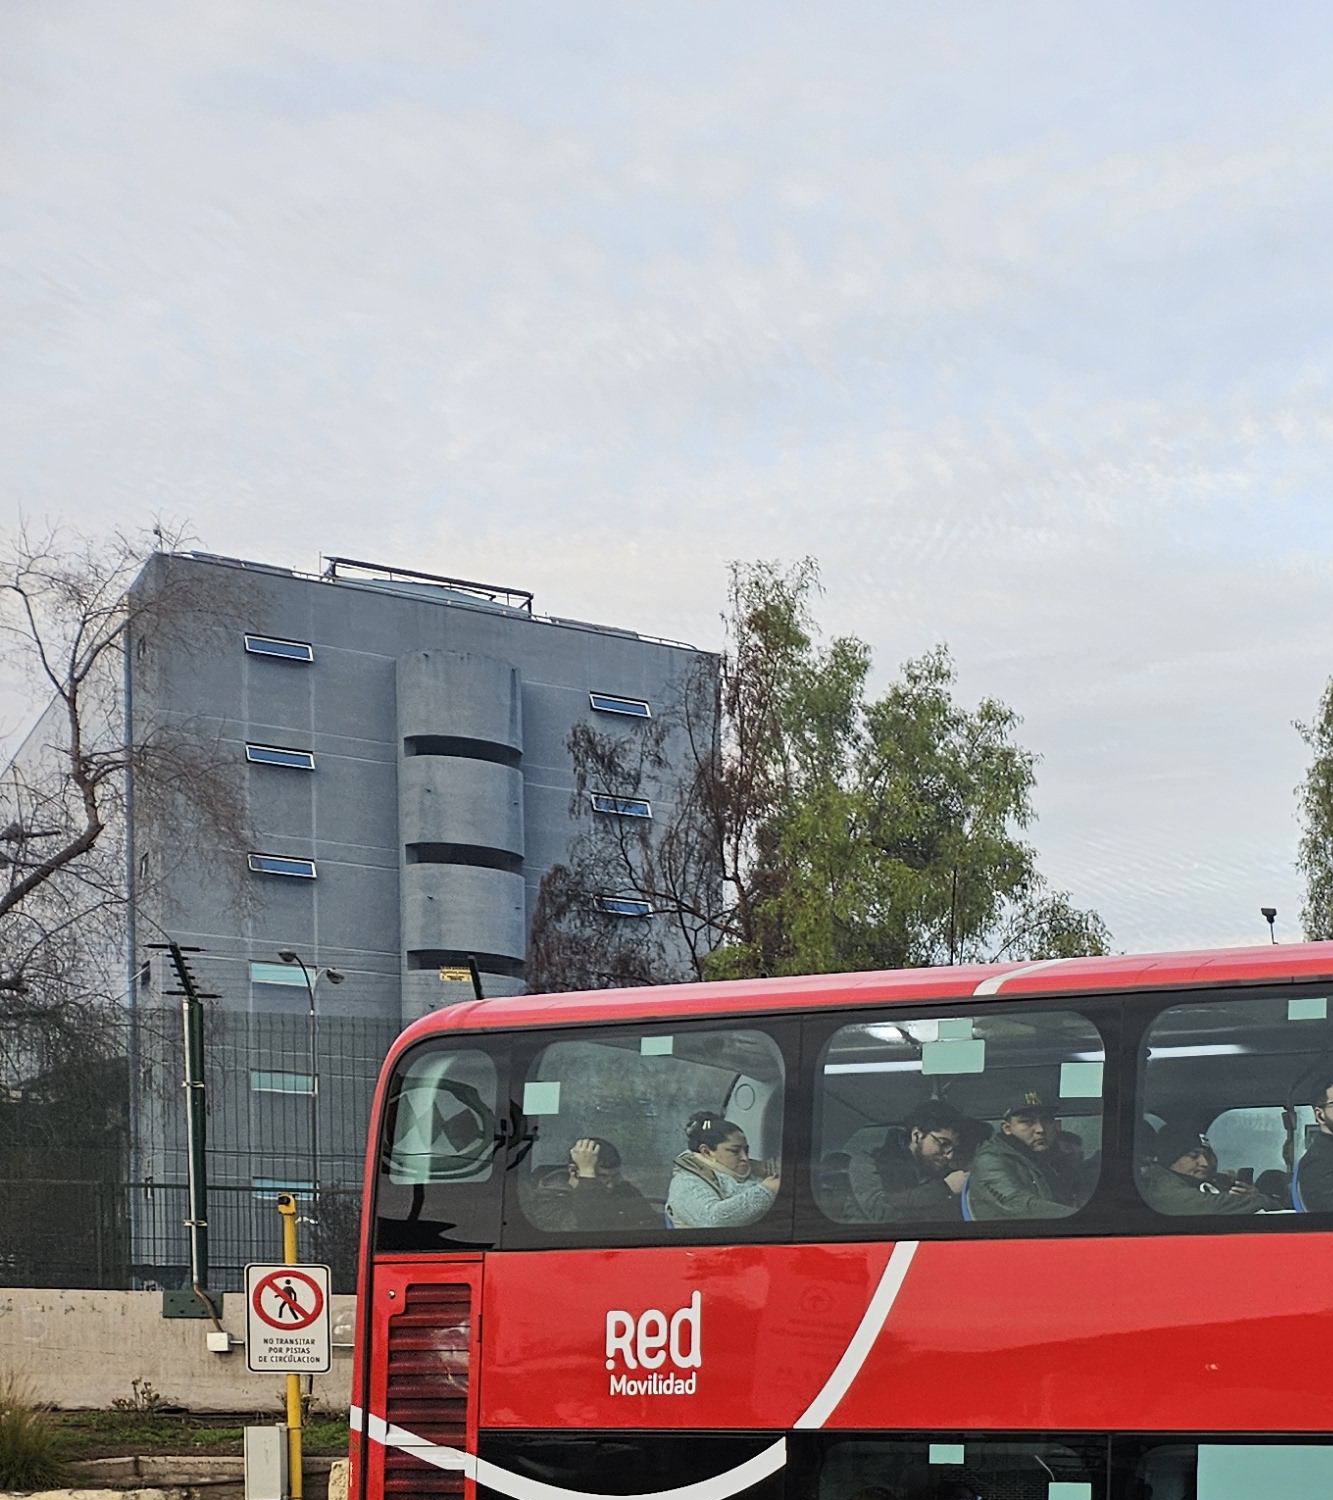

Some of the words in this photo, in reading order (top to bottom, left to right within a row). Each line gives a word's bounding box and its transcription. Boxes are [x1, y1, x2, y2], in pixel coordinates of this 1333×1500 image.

[605, 1289, 702, 1371] Red
[268, 1346, 283, 1354] POR
[258, 1355, 268, 1363] DE
[609, 1371, 697, 1396] Movilidad
